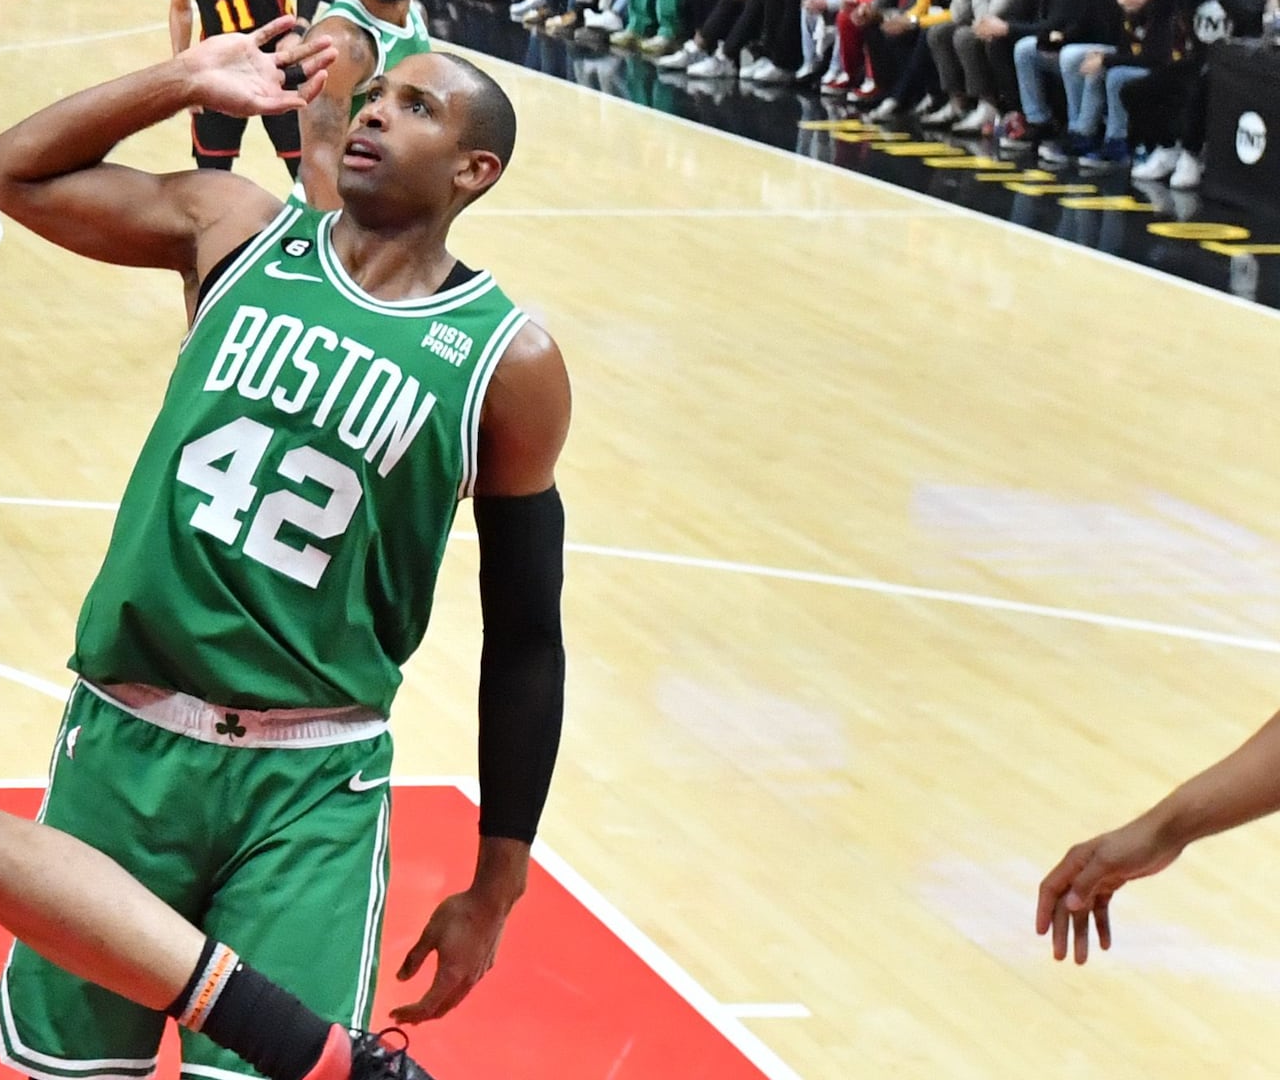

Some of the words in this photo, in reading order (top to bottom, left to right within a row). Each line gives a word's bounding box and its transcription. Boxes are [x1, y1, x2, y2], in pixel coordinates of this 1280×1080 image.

[284, 238, 309, 258] 6
[420, 335, 468, 369] PRINT
[428, 320, 473, 357] VISTA
[202, 303, 437, 481] BOSTON
[175, 415, 364, 592] 42
